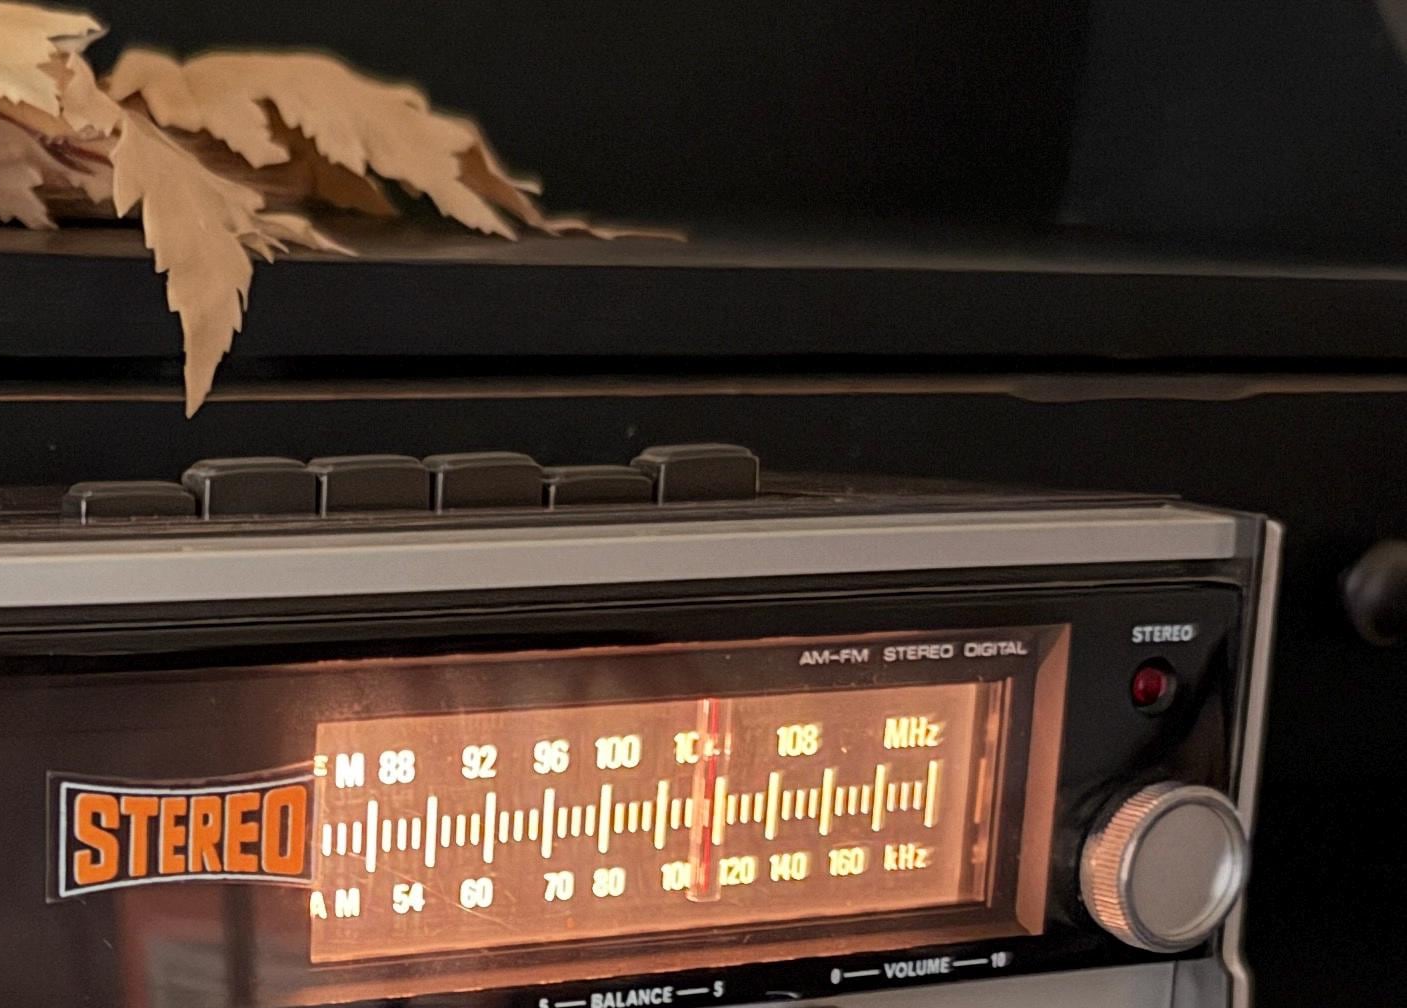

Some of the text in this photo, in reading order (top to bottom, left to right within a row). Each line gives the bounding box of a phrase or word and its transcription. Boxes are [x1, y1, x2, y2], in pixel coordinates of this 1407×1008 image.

[799, 640, 1028, 666] AM-FM STEREO DIGITAL
[1132, 624, 1194, 643] STEREO
[378, 749, 415, 785] 88
[461, 744, 497, 779] 92
[533, 738, 570, 775] 96
[595, 734, 641, 769] 100
[776, 722, 821, 757] 108
[883, 716, 942, 749] MHz
[73, 784, 307, 886] STEREO
[392, 881, 426, 915] 54
[460, 876, 494, 909] 60
[543, 870, 574, 902] 70
[592, 867, 626, 898] 80
[719, 856, 755, 886] 120
[769, 851, 808, 882] 140
[828, 846, 864, 877] 160
[883, 842, 930, 872] kHz
[884, 957, 951, 979] VOLUME
